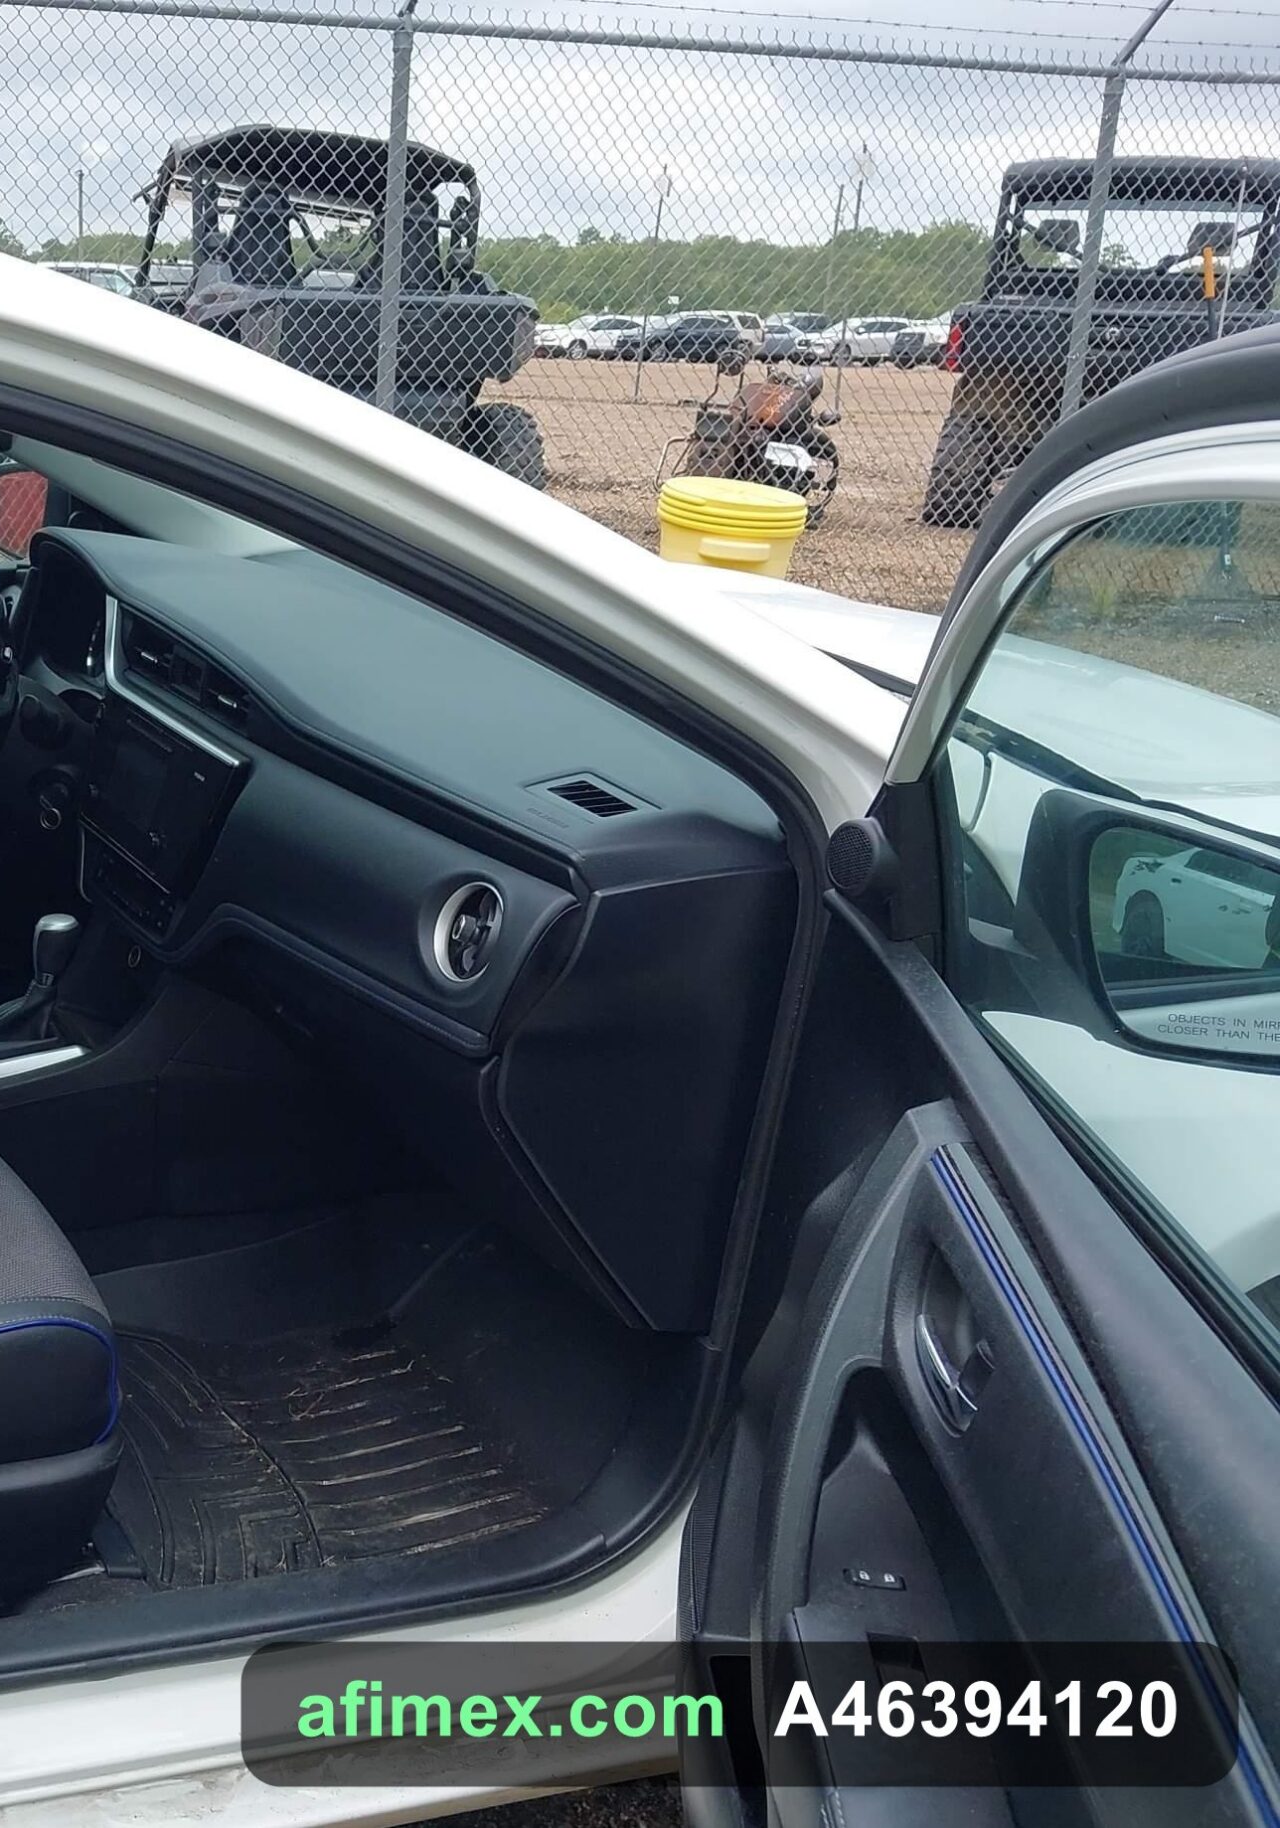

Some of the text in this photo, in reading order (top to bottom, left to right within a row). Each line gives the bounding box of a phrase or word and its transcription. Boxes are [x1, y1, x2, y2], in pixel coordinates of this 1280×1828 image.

[1168, 1013, 1226, 1026] OBJECTS
[1233, 1018, 1247, 1028] IN
[1157, 1024, 1208, 1036] CLOSER
[1216, 1029, 1250, 1040] THAN
